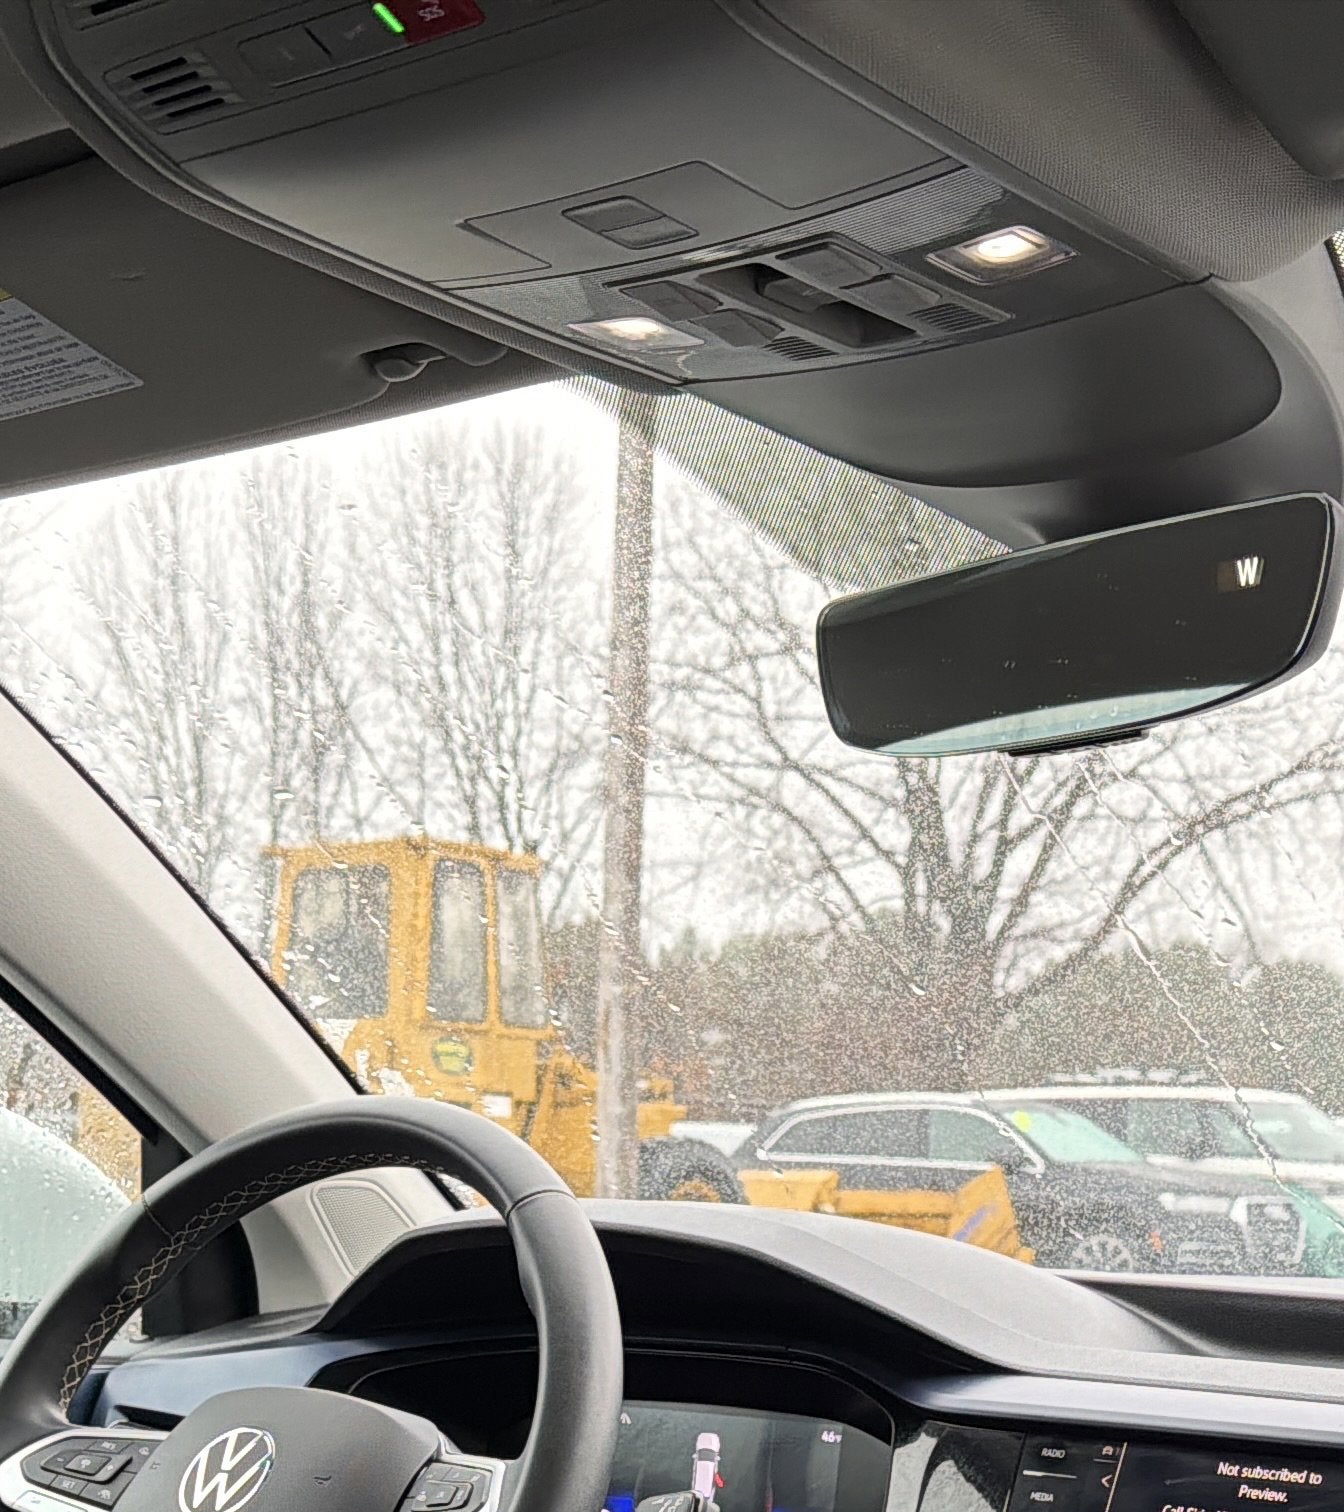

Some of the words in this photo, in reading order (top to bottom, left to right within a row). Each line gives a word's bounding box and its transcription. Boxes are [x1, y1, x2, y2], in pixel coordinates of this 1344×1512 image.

[1236, 556, 1259, 587] W
[1041, 1447, 1066, 1459] RADIO
[1217, 1461, 1240, 1477] Not
[1241, 1466, 1307, 1484] subscribed
[1308, 1472, 1323, 1485] to
[1029, 1491, 1054, 1503] MEDIA
[1238, 1484, 1289, 1503] Preview.
